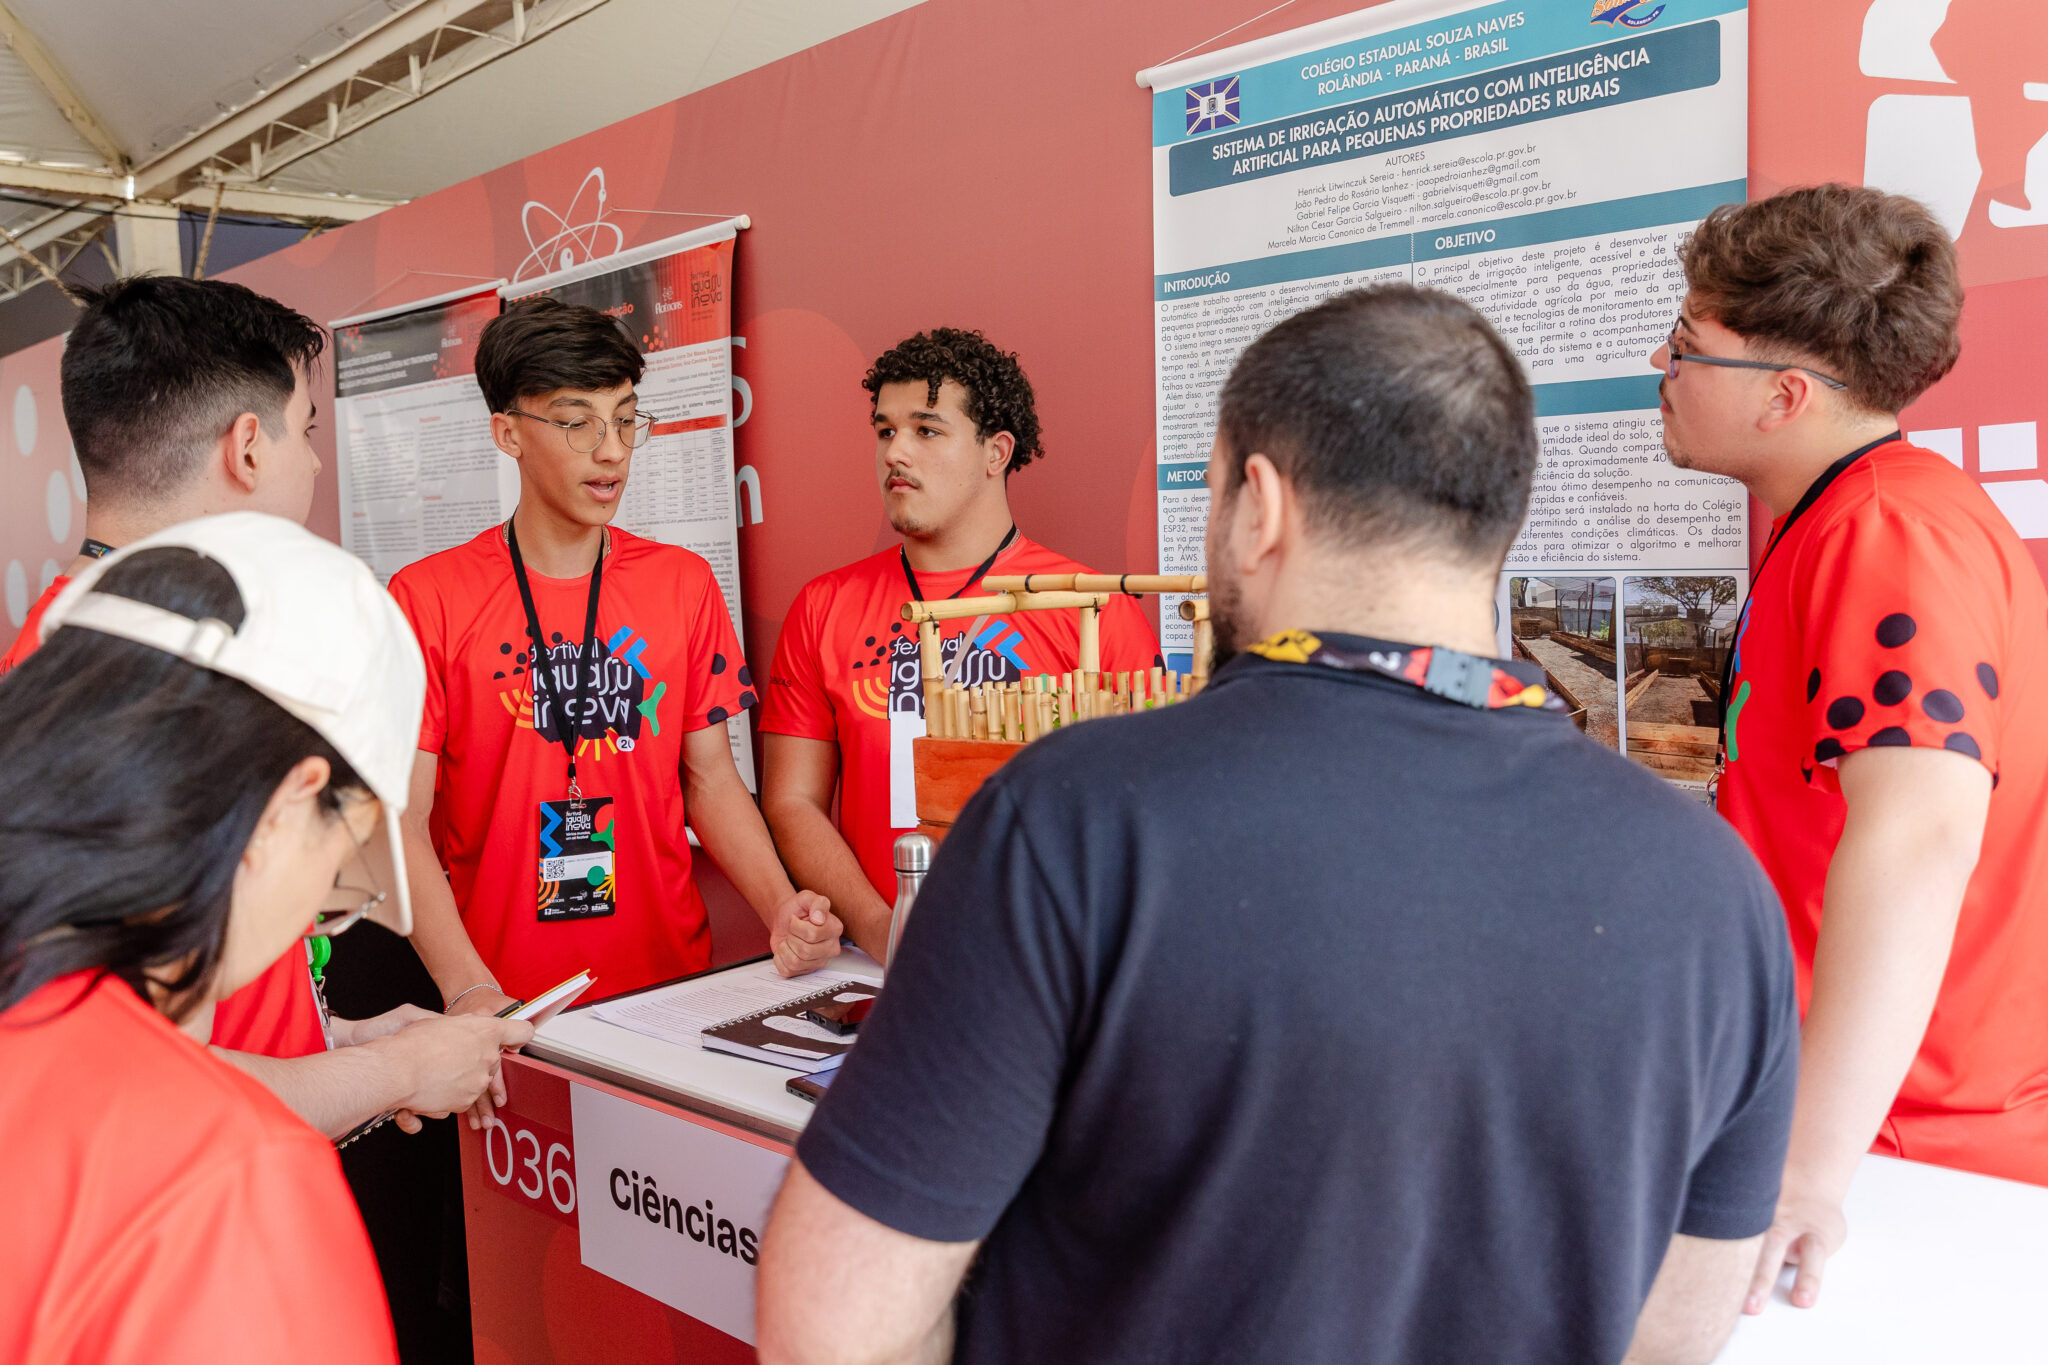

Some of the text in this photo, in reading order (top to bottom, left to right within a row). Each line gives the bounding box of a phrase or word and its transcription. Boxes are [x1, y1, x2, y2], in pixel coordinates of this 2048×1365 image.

[1301, 12, 1524, 80] COLÉGIO ESTADUAL SOUZA NAVES
[1318, 67, 1382, 95] ROLÂNDIA
[1395, 47, 1450, 76] PARANÁ
[1464, 37, 1509, 60] BRASIL
[1212, 48, 1650, 159] SISTEMA DE IRRIGAÇÃO AUTOMÁTICO COM INTELIGÊNCIA
[1232, 79, 1619, 174] ARTIFICIAL PARA PEQUENAS PROPRIEDADES RURAIS
[1385, 150, 1425, 167] AUTORES
[1297, 182, 1326, 197] Henrick
[1369, 170, 1394, 183] Sereia
[1294, 198, 1311, 209] João
[1314, 193, 1336, 206] Pedro
[1338, 190, 1348, 201] do
[1351, 185, 1379, 199] Rosário
[1296, 206, 1324, 221] Gabriel
[1327, 203, 1350, 216] Felipe
[1352, 197, 1379, 210] Garcia
[1382, 190, 1414, 206] Visquetti
[1287, 222, 1309, 234] Nilton
[1311, 220, 1333, 230] Cesar
[1336, 212, 1362, 225] Garcia
[1365, 206, 1402, 221] Salgueiro
[1267, 235, 1296, 249] Marcela
[1298, 231, 1325, 244] Marcia
[1328, 225, 1364, 239] Canonico
[1366, 222, 1376, 232] de
[1435, 229, 1496, 250] OBJETIVO
[1434, 233, 1667, 277] principal objetivo deste projeto desenvolver
[1418, 248, 1631, 287] automático irrigação inteligente, acessível
[1456, 256, 1678, 295] especialmente para pequenas propriedades
[1164, 271, 1231, 293] INTRODUÇÃO
[1490, 289, 1526, 300] otimizar
[1585, 278, 1613, 290] água,
[1620, 271, 1655, 284] reduzir
[1544, 286, 1637, 308] agrícola por meio
[1513, 297, 1653, 321] tecnologias monitoramento
[1522, 309, 1672, 332] facilitar rotina dos produtores
[1516, 330, 1574, 348] que permite
[1559, 342, 1592, 352] sistema
[1532, 359, 1553, 370] para
[1595, 348, 1646, 363] agricultura
[1542, 417, 1645, 436] que sistema atingiu
[1542, 429, 1651, 444] umidade ideal solo,
[1543, 443, 1618, 456] falhas. Quando
[1562, 454, 1648, 470] aproximadamente
[1593, 466, 1632, 480] solução.
[1561, 481, 1587, 491] ótimo
[1591, 477, 1652, 491] desempenho
[1531, 490, 1626, 506] rápidas confiáveis.
[1565, 499, 1741, 514] será instalado horta Colégio
[1520, 524, 1741, 540] diferentes condições climáticas. dados
[1529, 512, 1720, 530] permitindo análise desempenho
[1540, 551, 1640, 561] eficiência sistema.
[1543, 537, 1741, 553] para otimizar algoritmo melhorar
[486, 1118, 576, 1214] 036
[609, 1167, 759, 1266] Ciências
